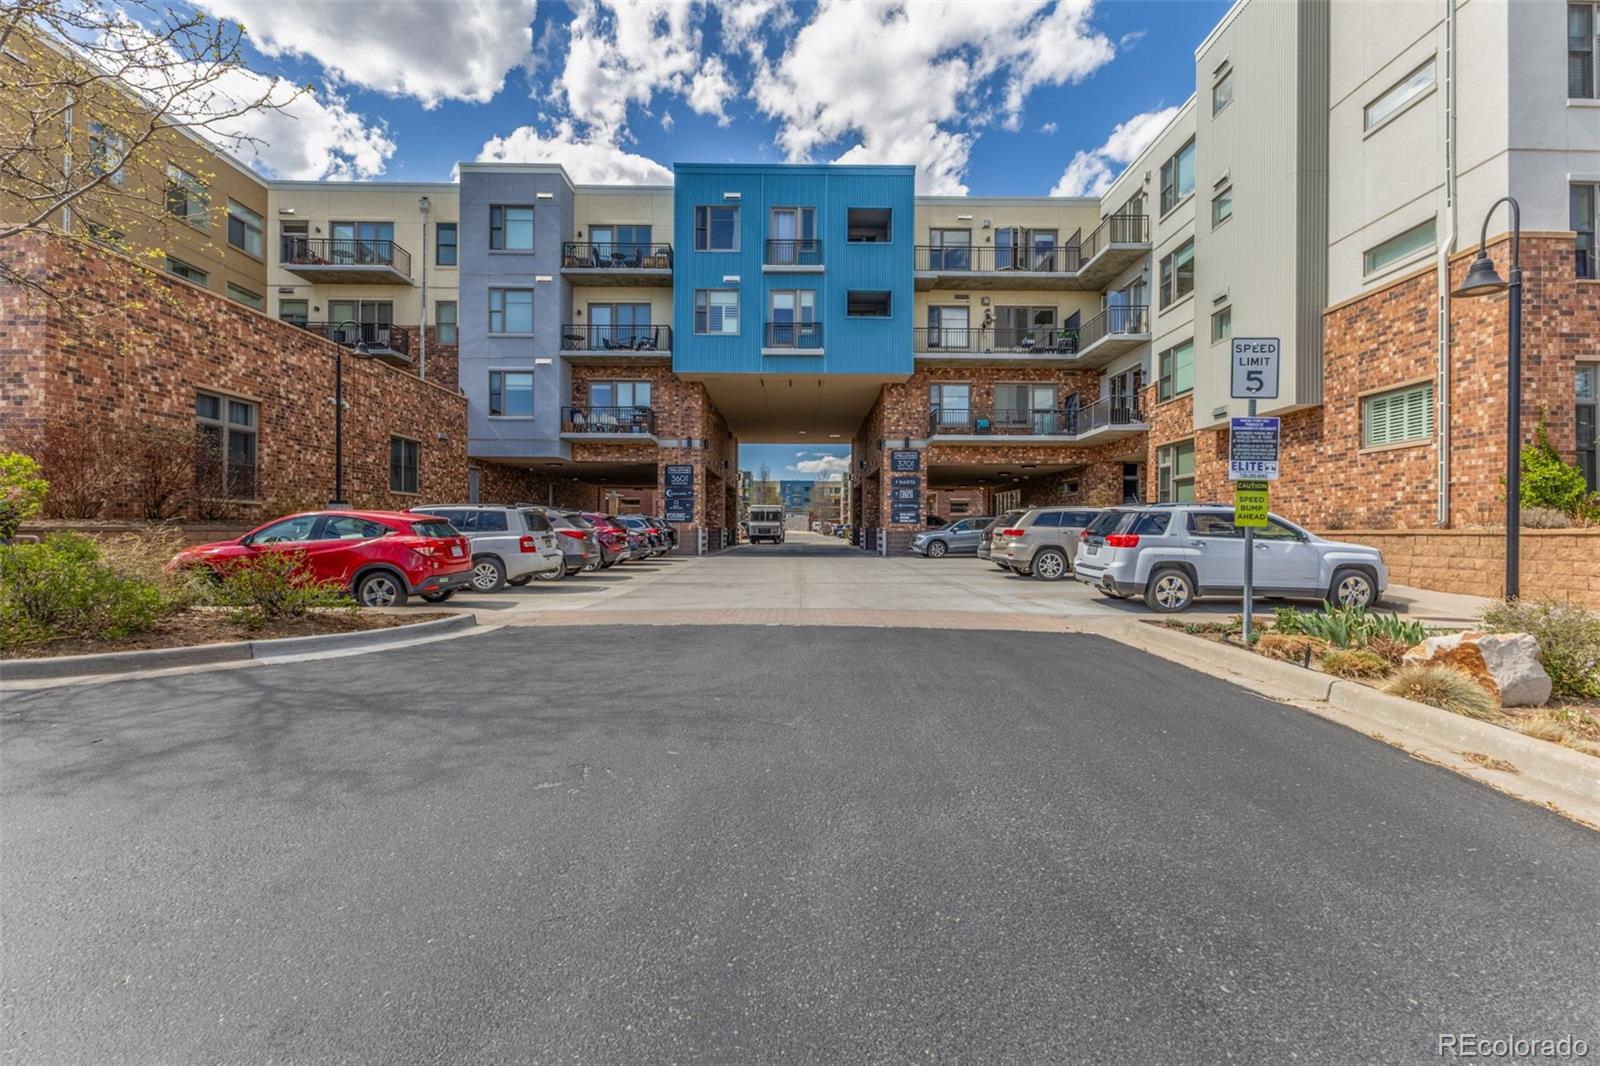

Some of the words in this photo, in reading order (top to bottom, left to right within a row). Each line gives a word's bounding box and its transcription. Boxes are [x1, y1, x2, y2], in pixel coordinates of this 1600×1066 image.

[1235, 344, 1276, 353] SPEED
[1239, 357, 1271, 366] LIMIT
[1246, 370, 1264, 392] 5
[1231, 461, 1264, 471] ELITE
